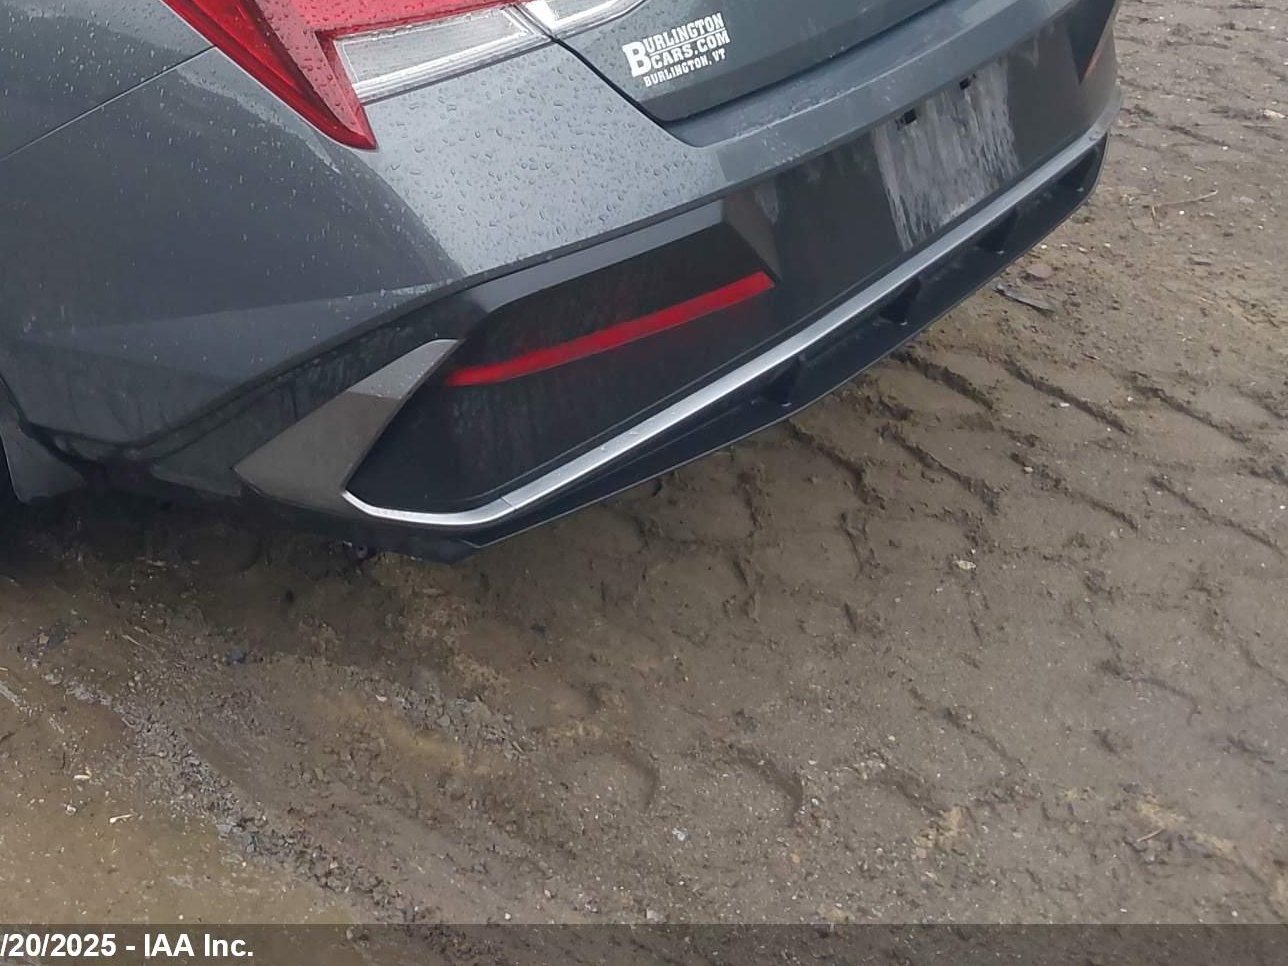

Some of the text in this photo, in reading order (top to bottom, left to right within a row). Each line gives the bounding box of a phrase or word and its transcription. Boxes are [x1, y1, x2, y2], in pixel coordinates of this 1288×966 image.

[622, 12, 725, 77] BURLINGTON
[651, 30, 730, 69] CARS.COM
[712, 48, 726, 62] VT
